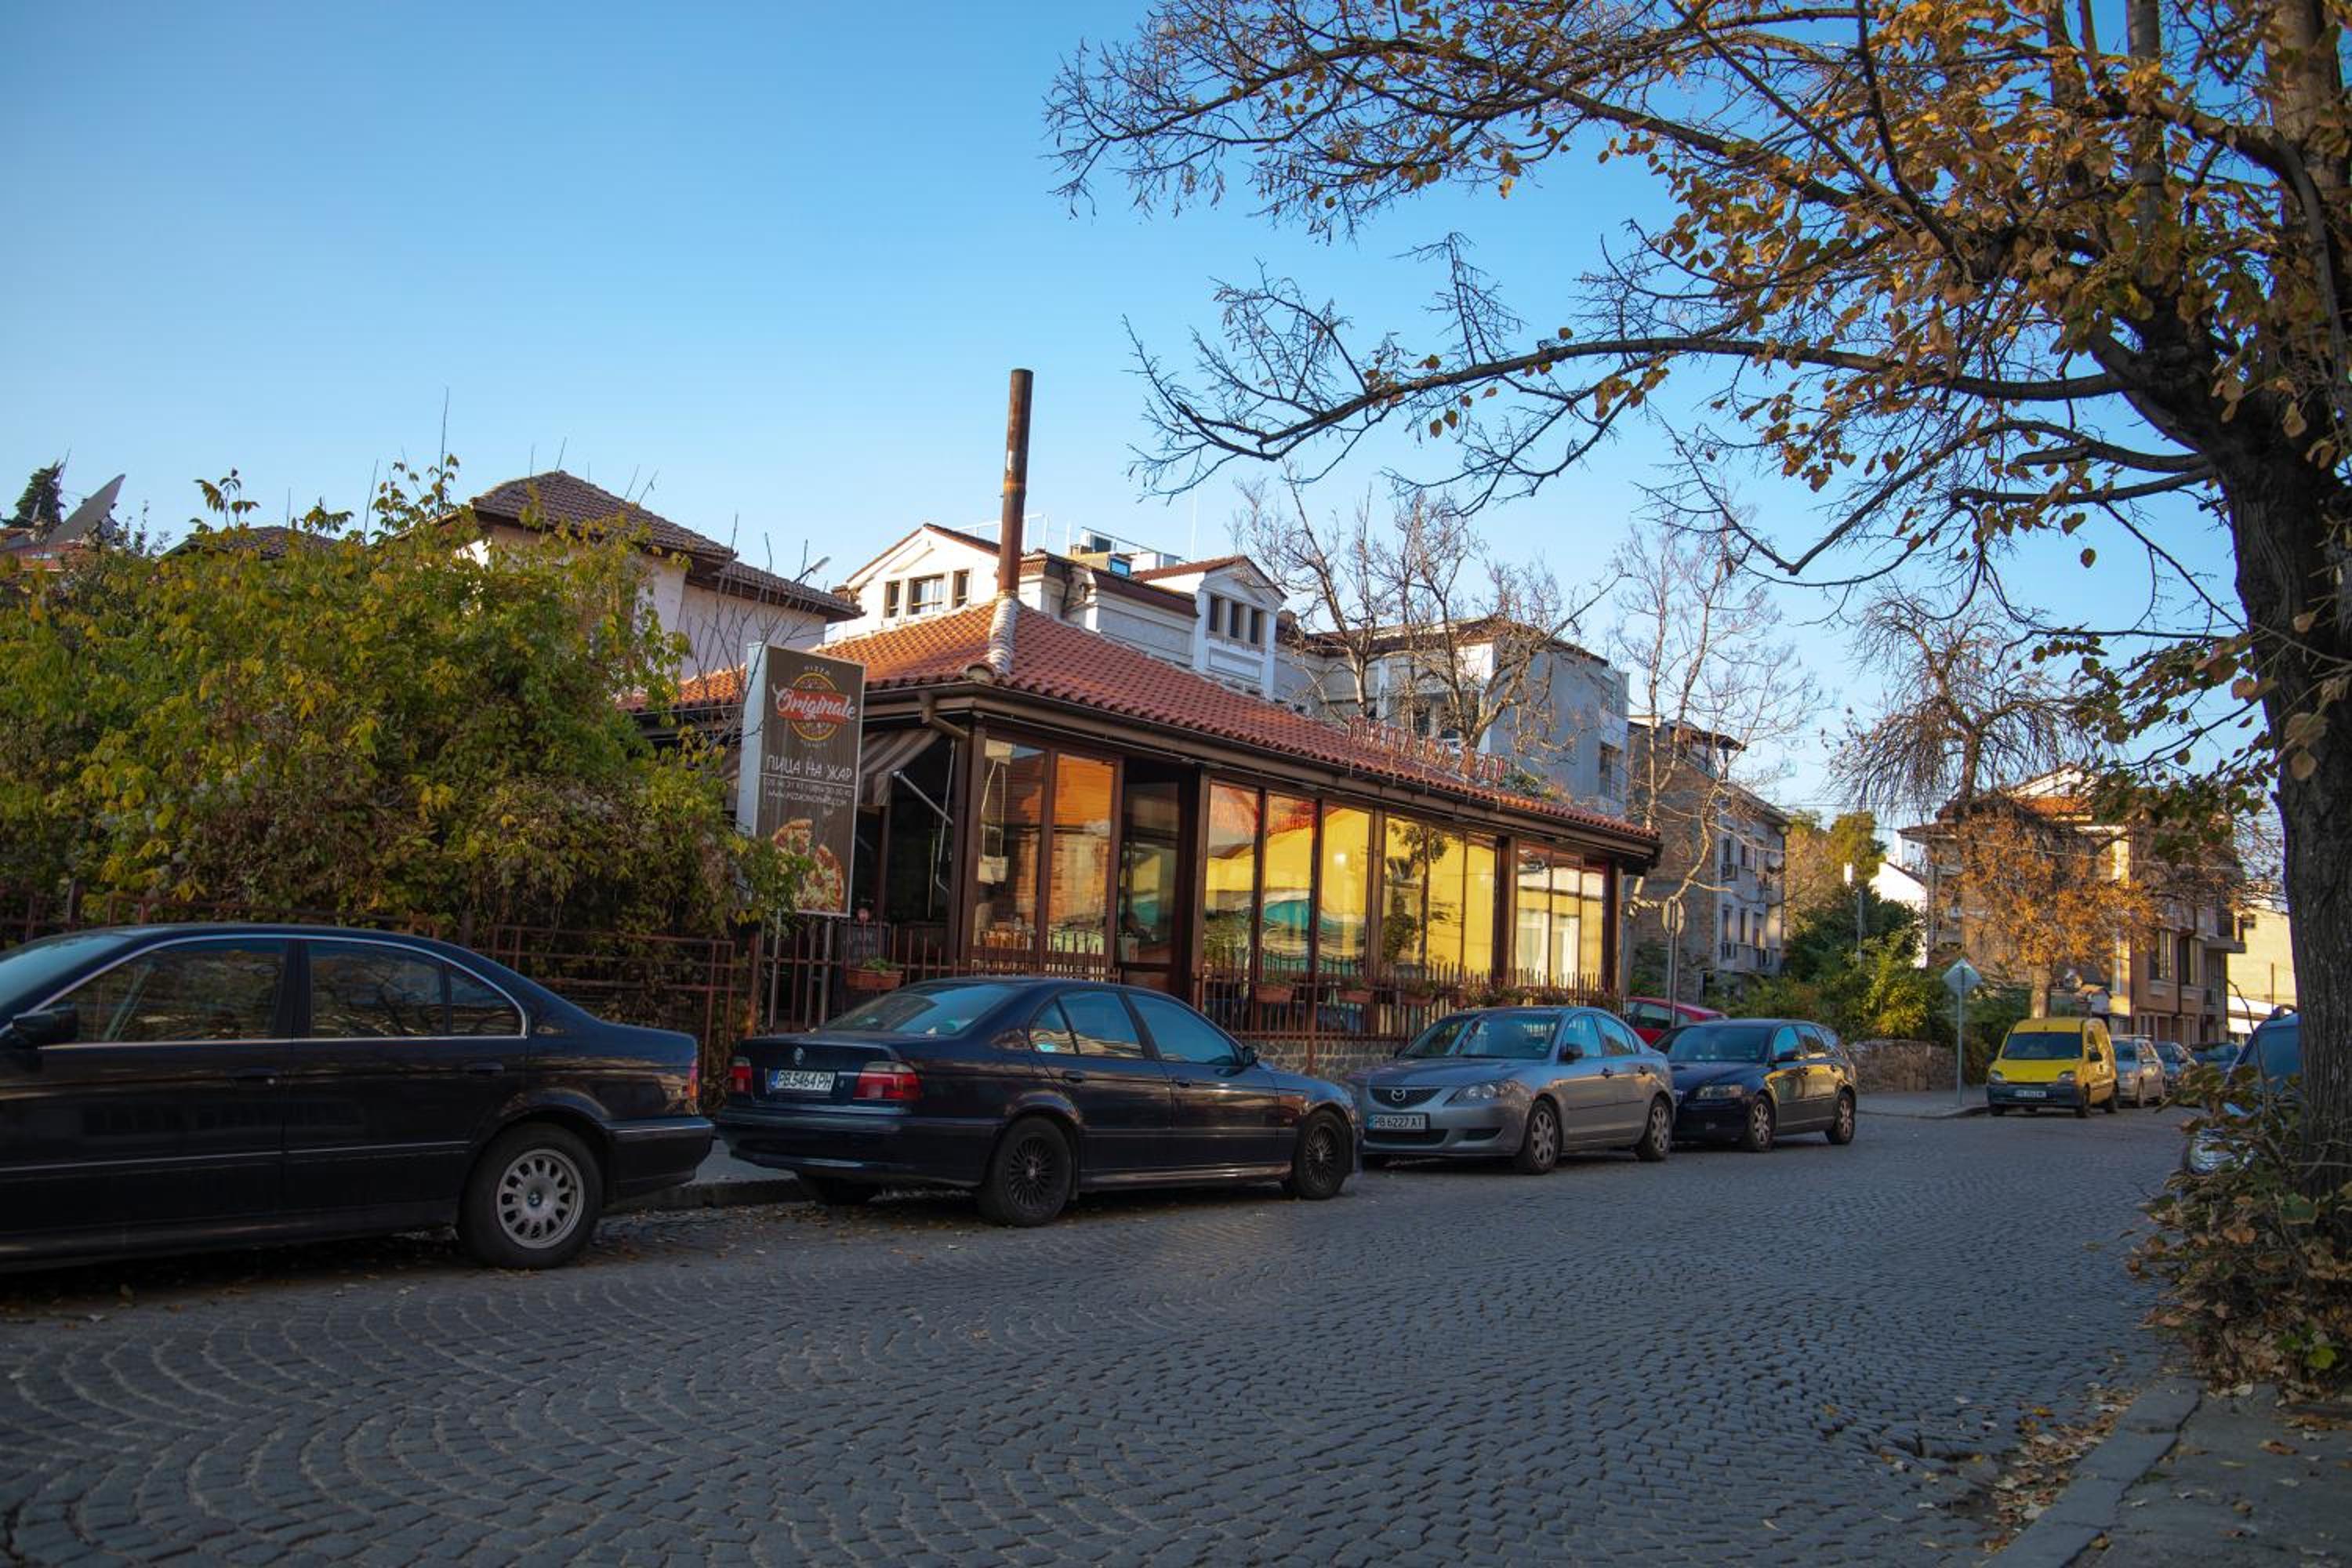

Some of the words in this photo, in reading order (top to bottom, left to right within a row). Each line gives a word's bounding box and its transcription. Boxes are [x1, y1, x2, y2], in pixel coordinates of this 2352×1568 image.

[766, 755, 800, 775] ПИЦА
[806, 760, 822, 777] НА
[826, 764, 852, 781] ЖАР
